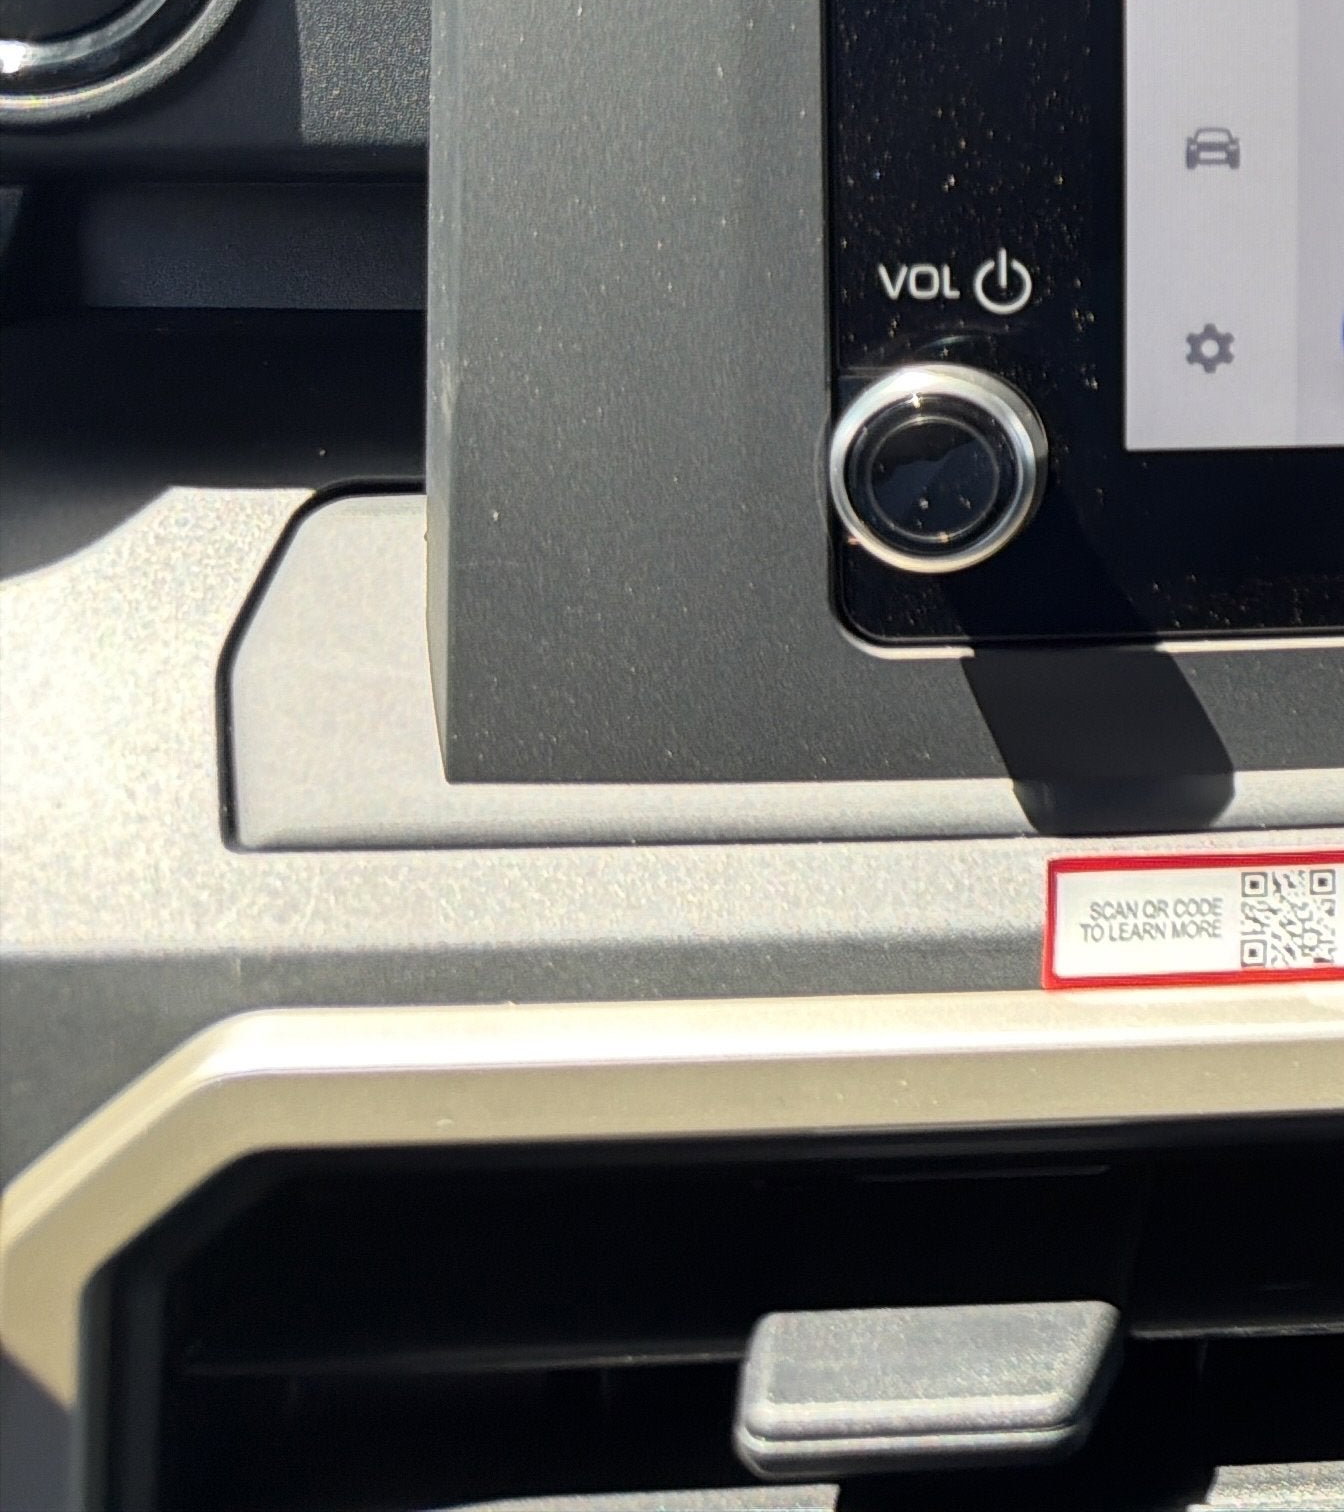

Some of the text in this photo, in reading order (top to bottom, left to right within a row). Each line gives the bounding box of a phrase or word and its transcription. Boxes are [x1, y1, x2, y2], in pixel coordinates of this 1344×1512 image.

[877, 262, 961, 301] VOL
[1090, 898, 1223, 921] SCAN QR CODE
[1082, 920, 1222, 942] TO LEARN MORE
